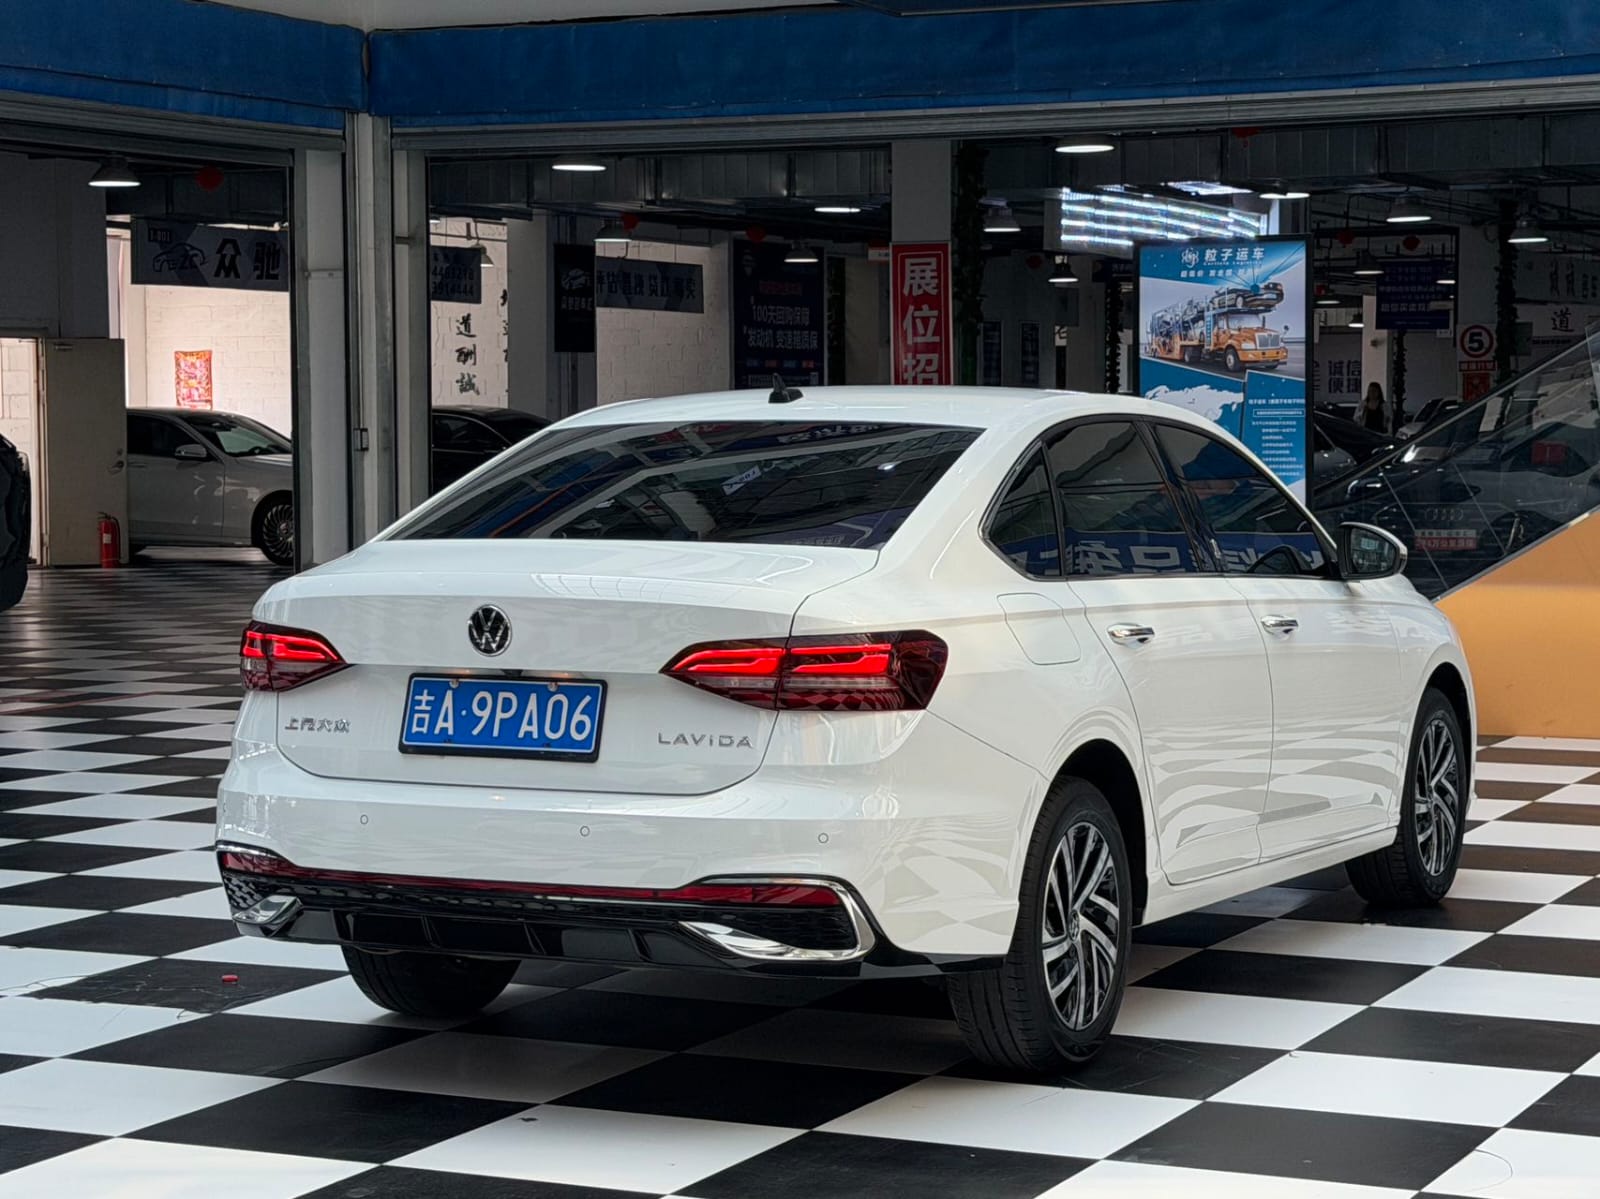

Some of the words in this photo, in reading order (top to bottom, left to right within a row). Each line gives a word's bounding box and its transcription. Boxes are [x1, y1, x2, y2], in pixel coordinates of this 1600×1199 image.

[214, 238, 281, 280] 众驰
[1204, 247, 1265, 262] 粒子运车
[1551, 306, 1575, 332] 道
[1468, 331, 1485, 352] 5
